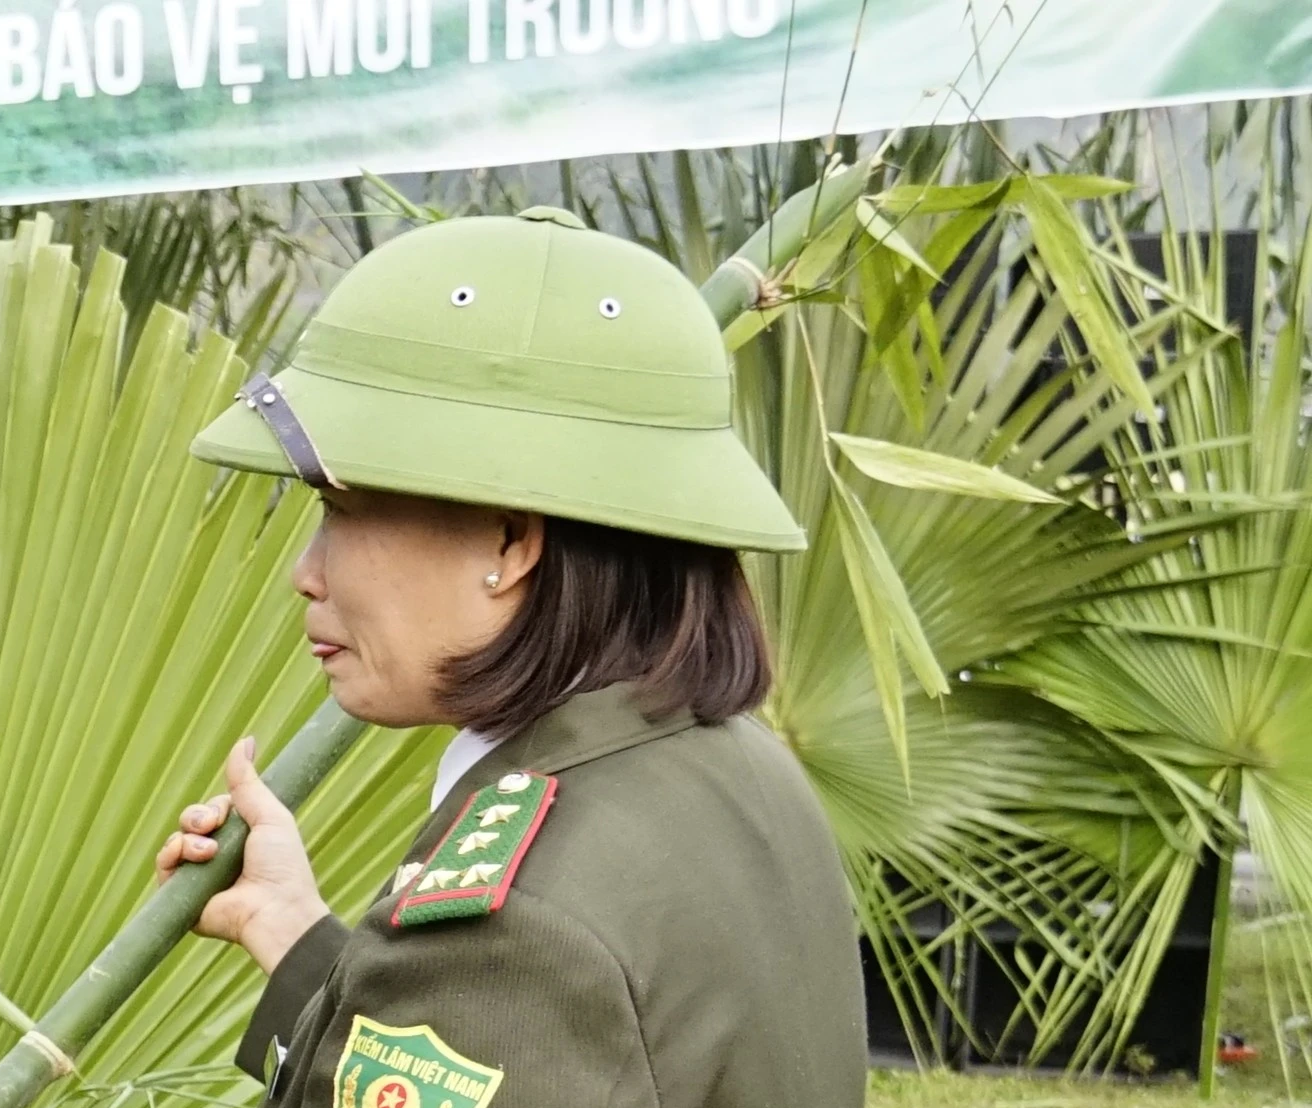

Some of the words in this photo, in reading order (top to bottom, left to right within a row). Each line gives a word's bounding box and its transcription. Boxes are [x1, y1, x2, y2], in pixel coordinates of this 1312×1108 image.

[353, 1034, 384, 1060] KIỂM
[377, 1045, 414, 1073] LÂM
[411, 1057, 447, 1084] VIỆT
[443, 1071, 486, 1101] NAM
